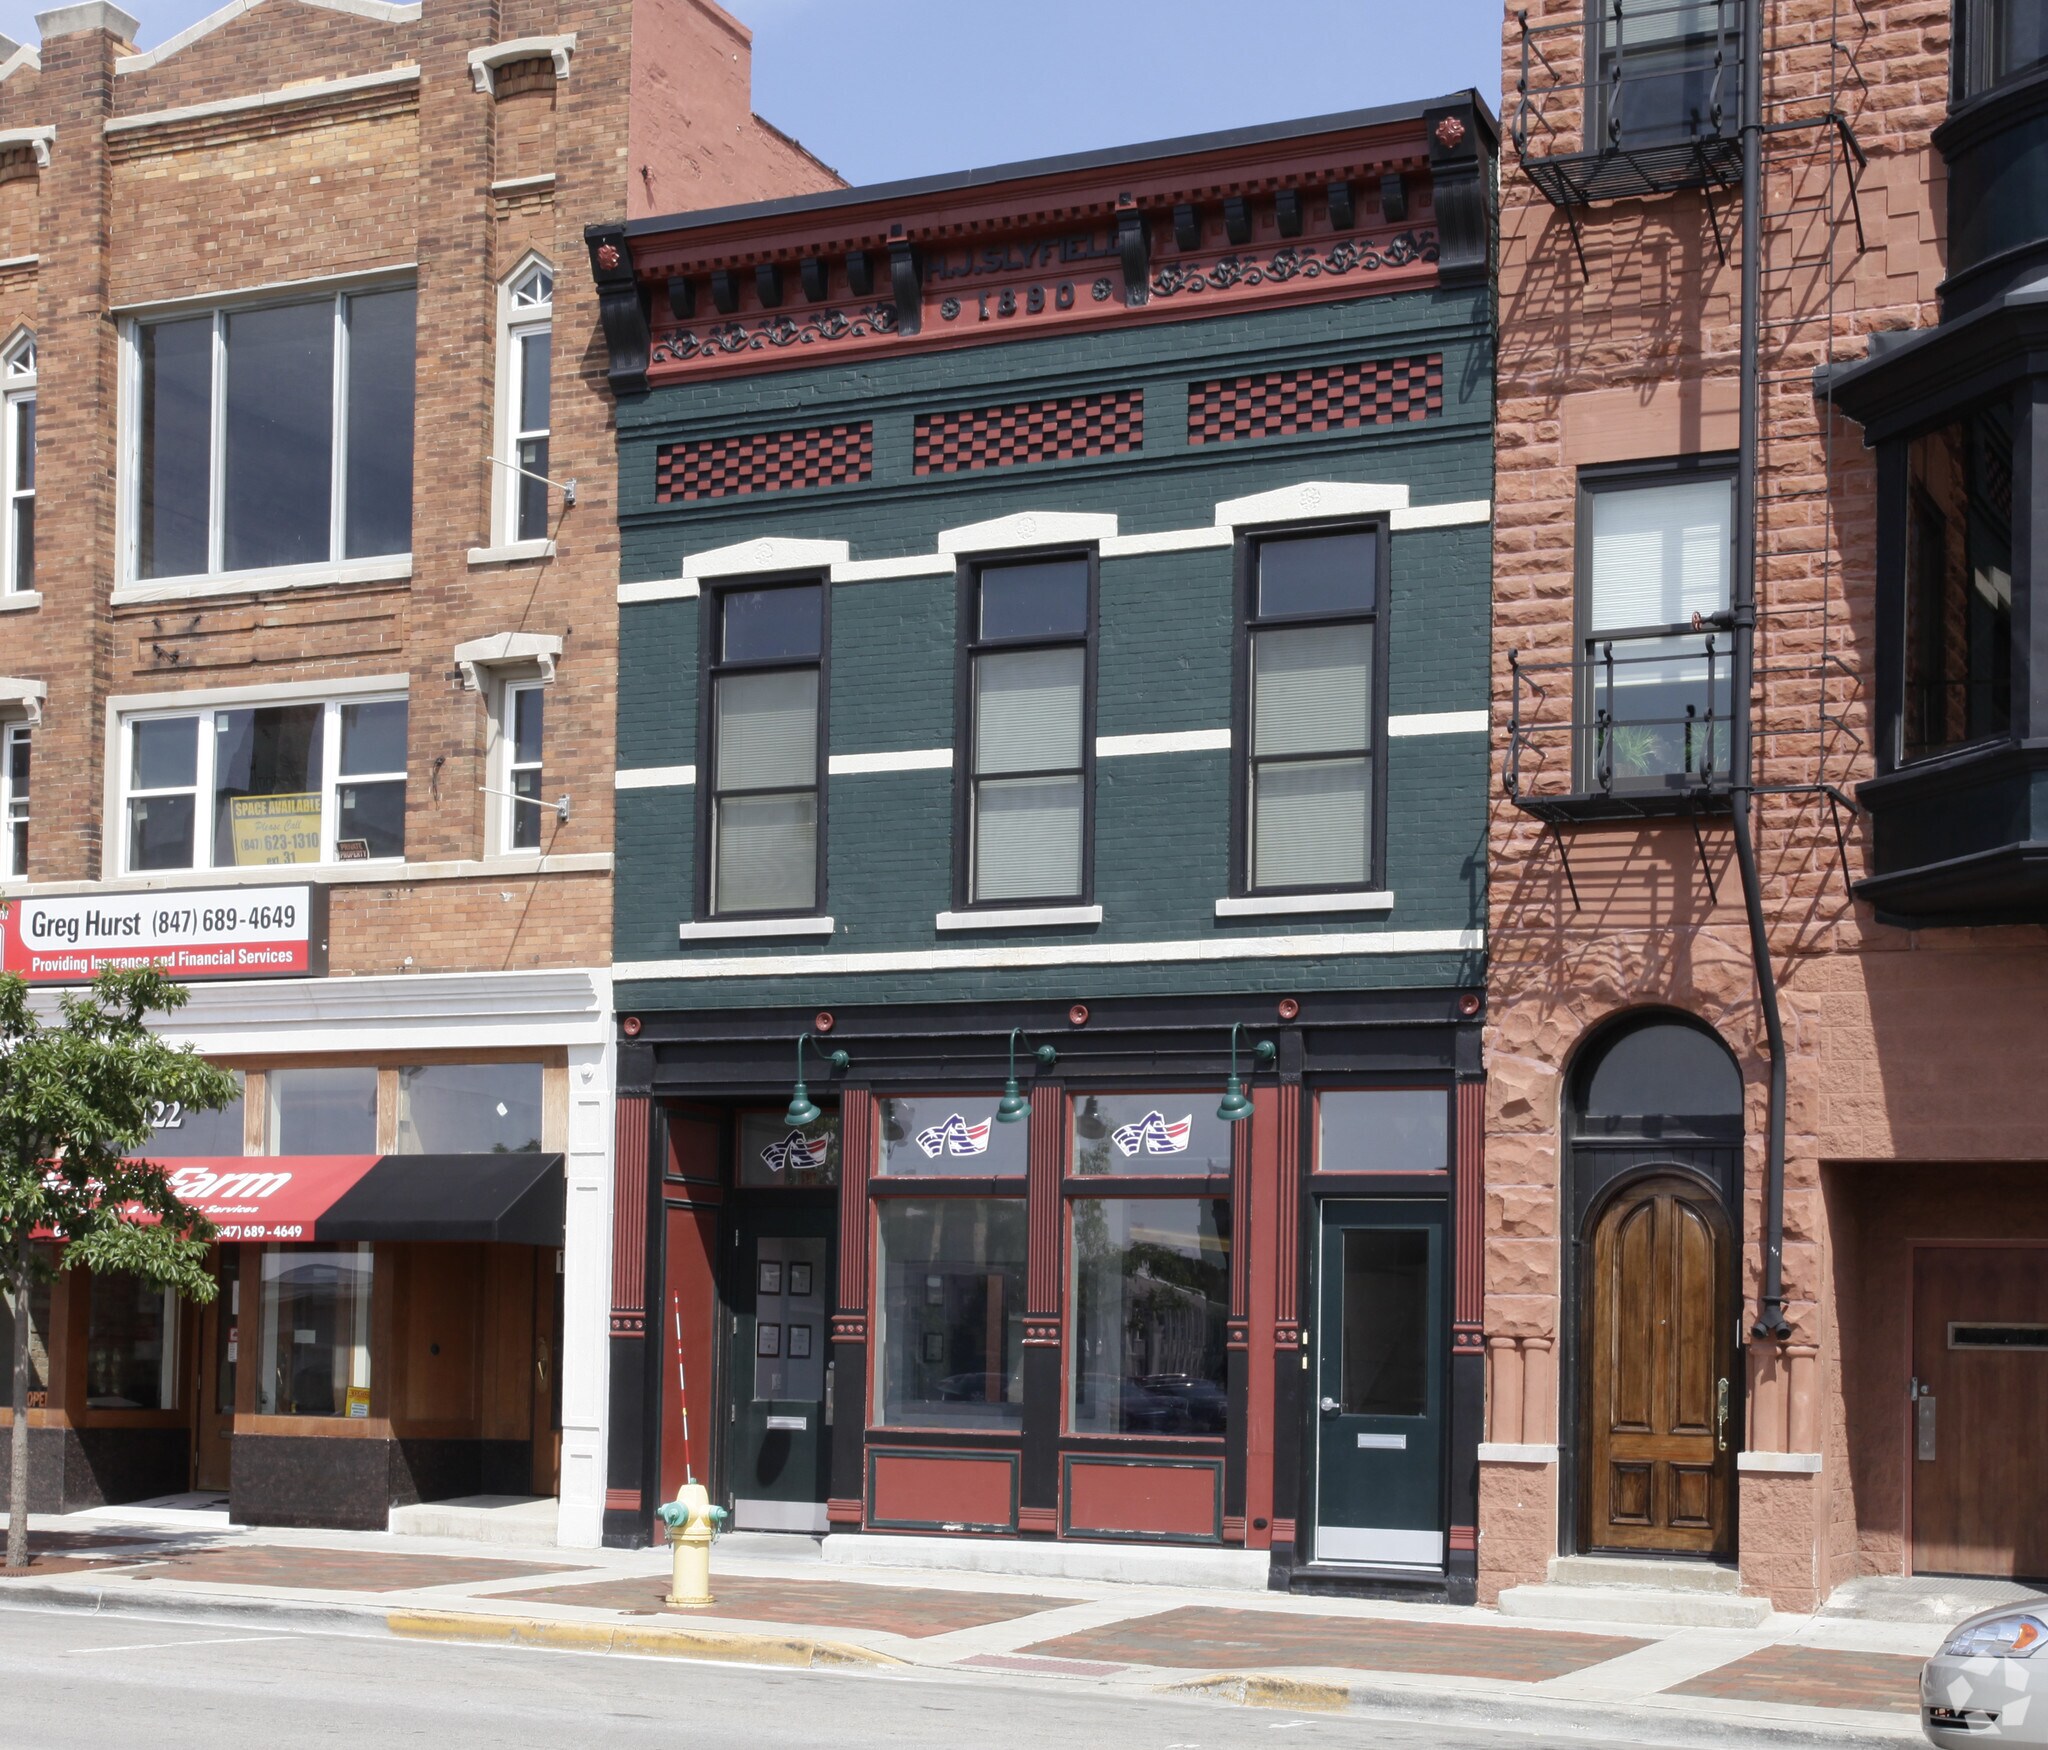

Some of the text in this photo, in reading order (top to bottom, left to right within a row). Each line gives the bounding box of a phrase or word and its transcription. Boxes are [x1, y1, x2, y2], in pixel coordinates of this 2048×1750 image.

[978, 281, 1075, 321] 1890
[235, 798, 321, 817] SPACE AVAILABLE
[254, 818, 302, 832] Please Call
[240, 832, 320, 851] (847) 623-1310
[283, 851, 296, 864] 31
[32, 905, 295, 943] Greg Hurst (847) 689-4649
[32, 948, 293, 973] Providing Insurance and Financial Services
[166, 1167, 292, 1198] Farm
[204, 1205, 259, 1214] Services
[243, 1225, 302, 1238] 689-4649
